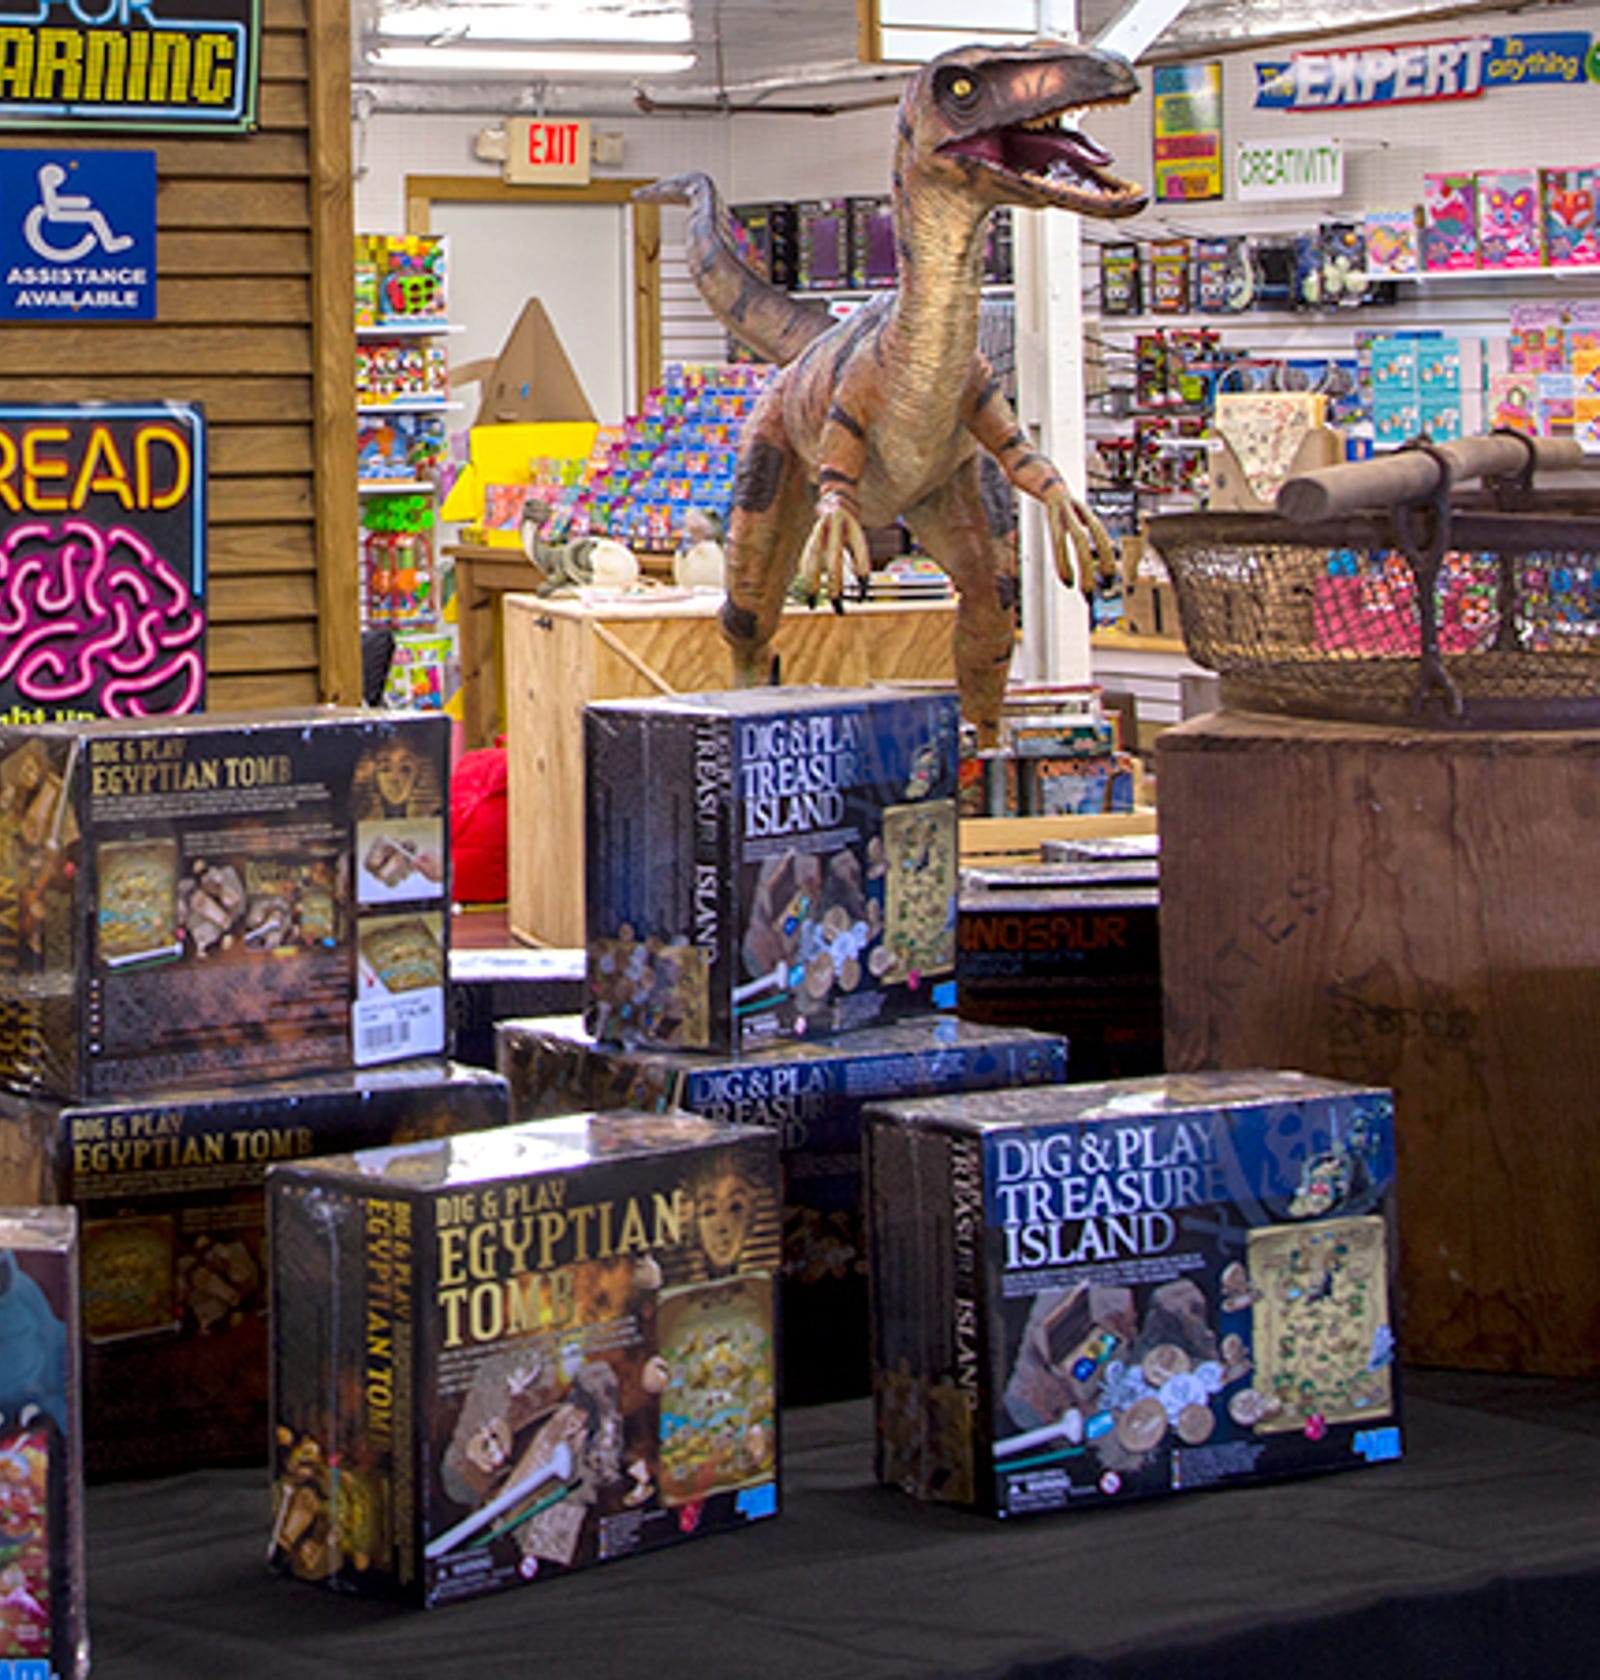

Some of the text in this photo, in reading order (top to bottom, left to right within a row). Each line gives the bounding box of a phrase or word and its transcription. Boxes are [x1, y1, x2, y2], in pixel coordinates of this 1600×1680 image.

[1293, 41, 1491, 105] EXPERT
[1505, 37, 1523, 54] in
[1488, 52, 1578, 80] anything
[529, 124, 578, 166] EXIT
[1238, 147, 1340, 186] CREATIVITY
[7, 267, 147, 285] ASSISTANCE
[14, 290, 139, 307] AVAILABLE
[742, 724, 787, 760] DIG
[91, 754, 292, 796] EGYPTIAN TOMB
[745, 791, 844, 838] ISLAND
[959, 915, 1127, 951] INOSAUR
[694, 1072, 742, 1103] DIG
[73, 1125, 314, 1173] EGYPTIAN TOMB
[998, 1119, 1224, 1184] DIG & PLAY
[436, 1177, 568, 1227] DIG & PLAY
[998, 1163, 1228, 1226] TREASURE
[437, 1188, 687, 1287] EGYPTIAN
[1005, 1212, 1177, 1269] ISLAND
[365, 1198, 393, 1359] EGYPTIAN
[438, 1269, 577, 1350] TOMB
